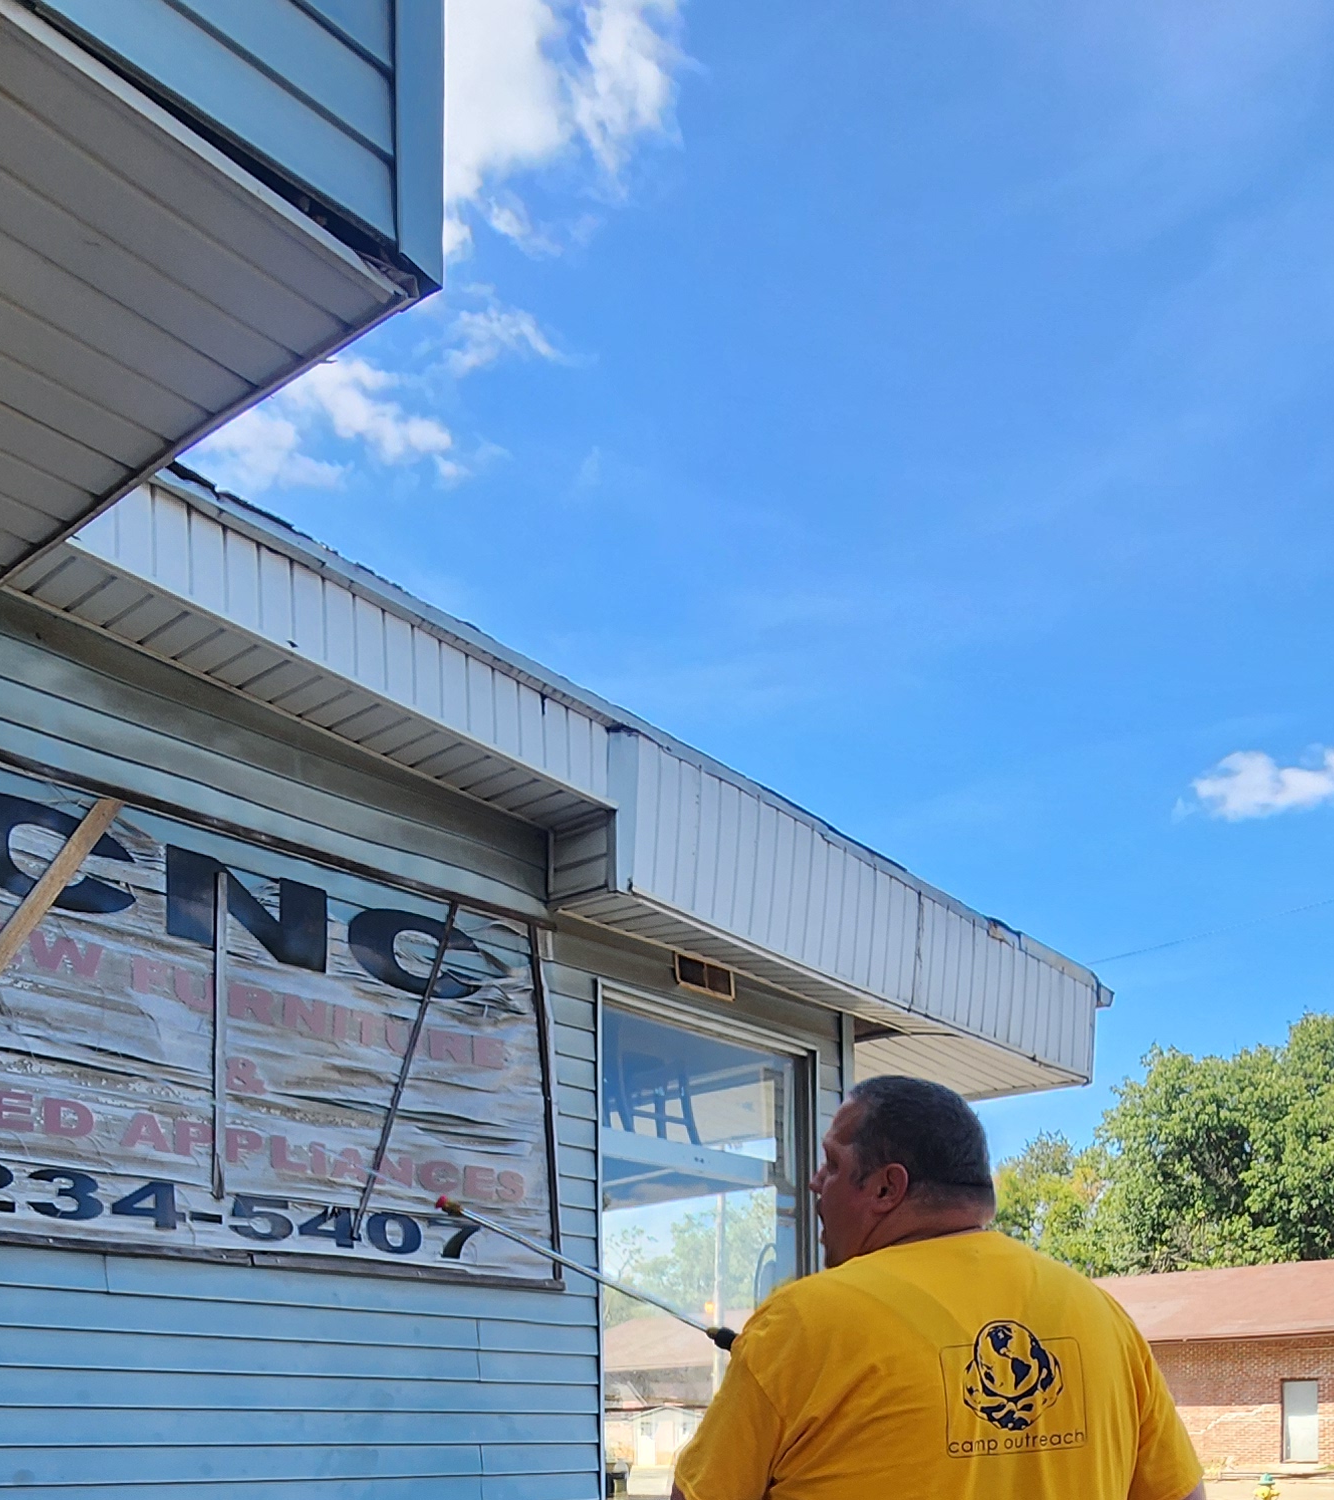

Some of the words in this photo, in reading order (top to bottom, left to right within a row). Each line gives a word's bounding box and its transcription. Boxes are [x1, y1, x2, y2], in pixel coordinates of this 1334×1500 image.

[130, 955, 506, 1071] FURNITURE
[225, 1056, 268, 1095] &
[119, 1111, 526, 1202] APPLIANCES
[948, 1438, 999, 1455] camp
[1003, 1429, 1085, 1449] outreach
